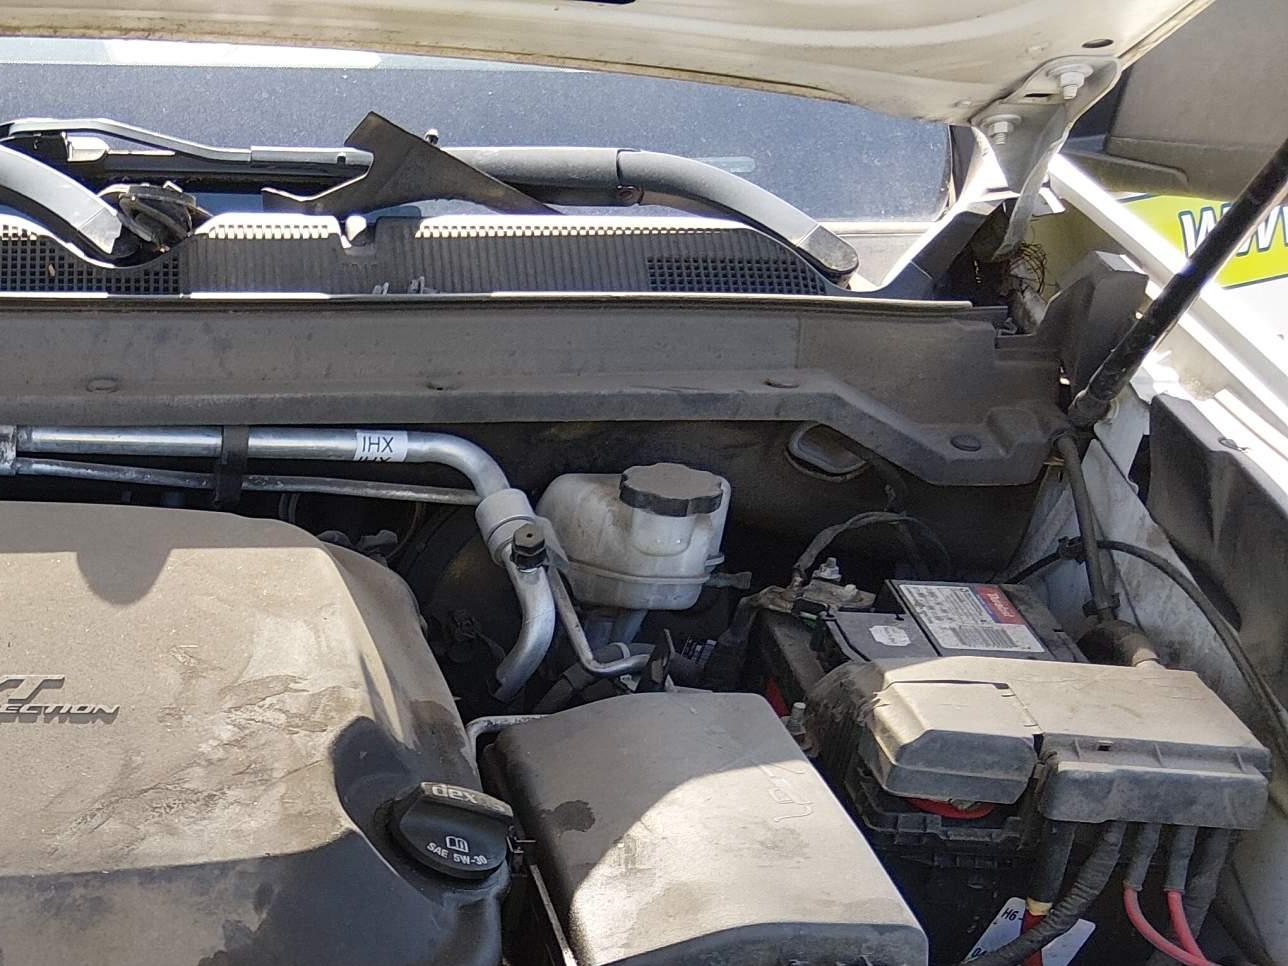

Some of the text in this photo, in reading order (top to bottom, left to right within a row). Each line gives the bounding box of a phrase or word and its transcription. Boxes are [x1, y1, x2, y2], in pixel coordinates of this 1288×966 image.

[361, 436, 394, 453] IHX
[427, 842, 488, 865] SAE 5W-30
